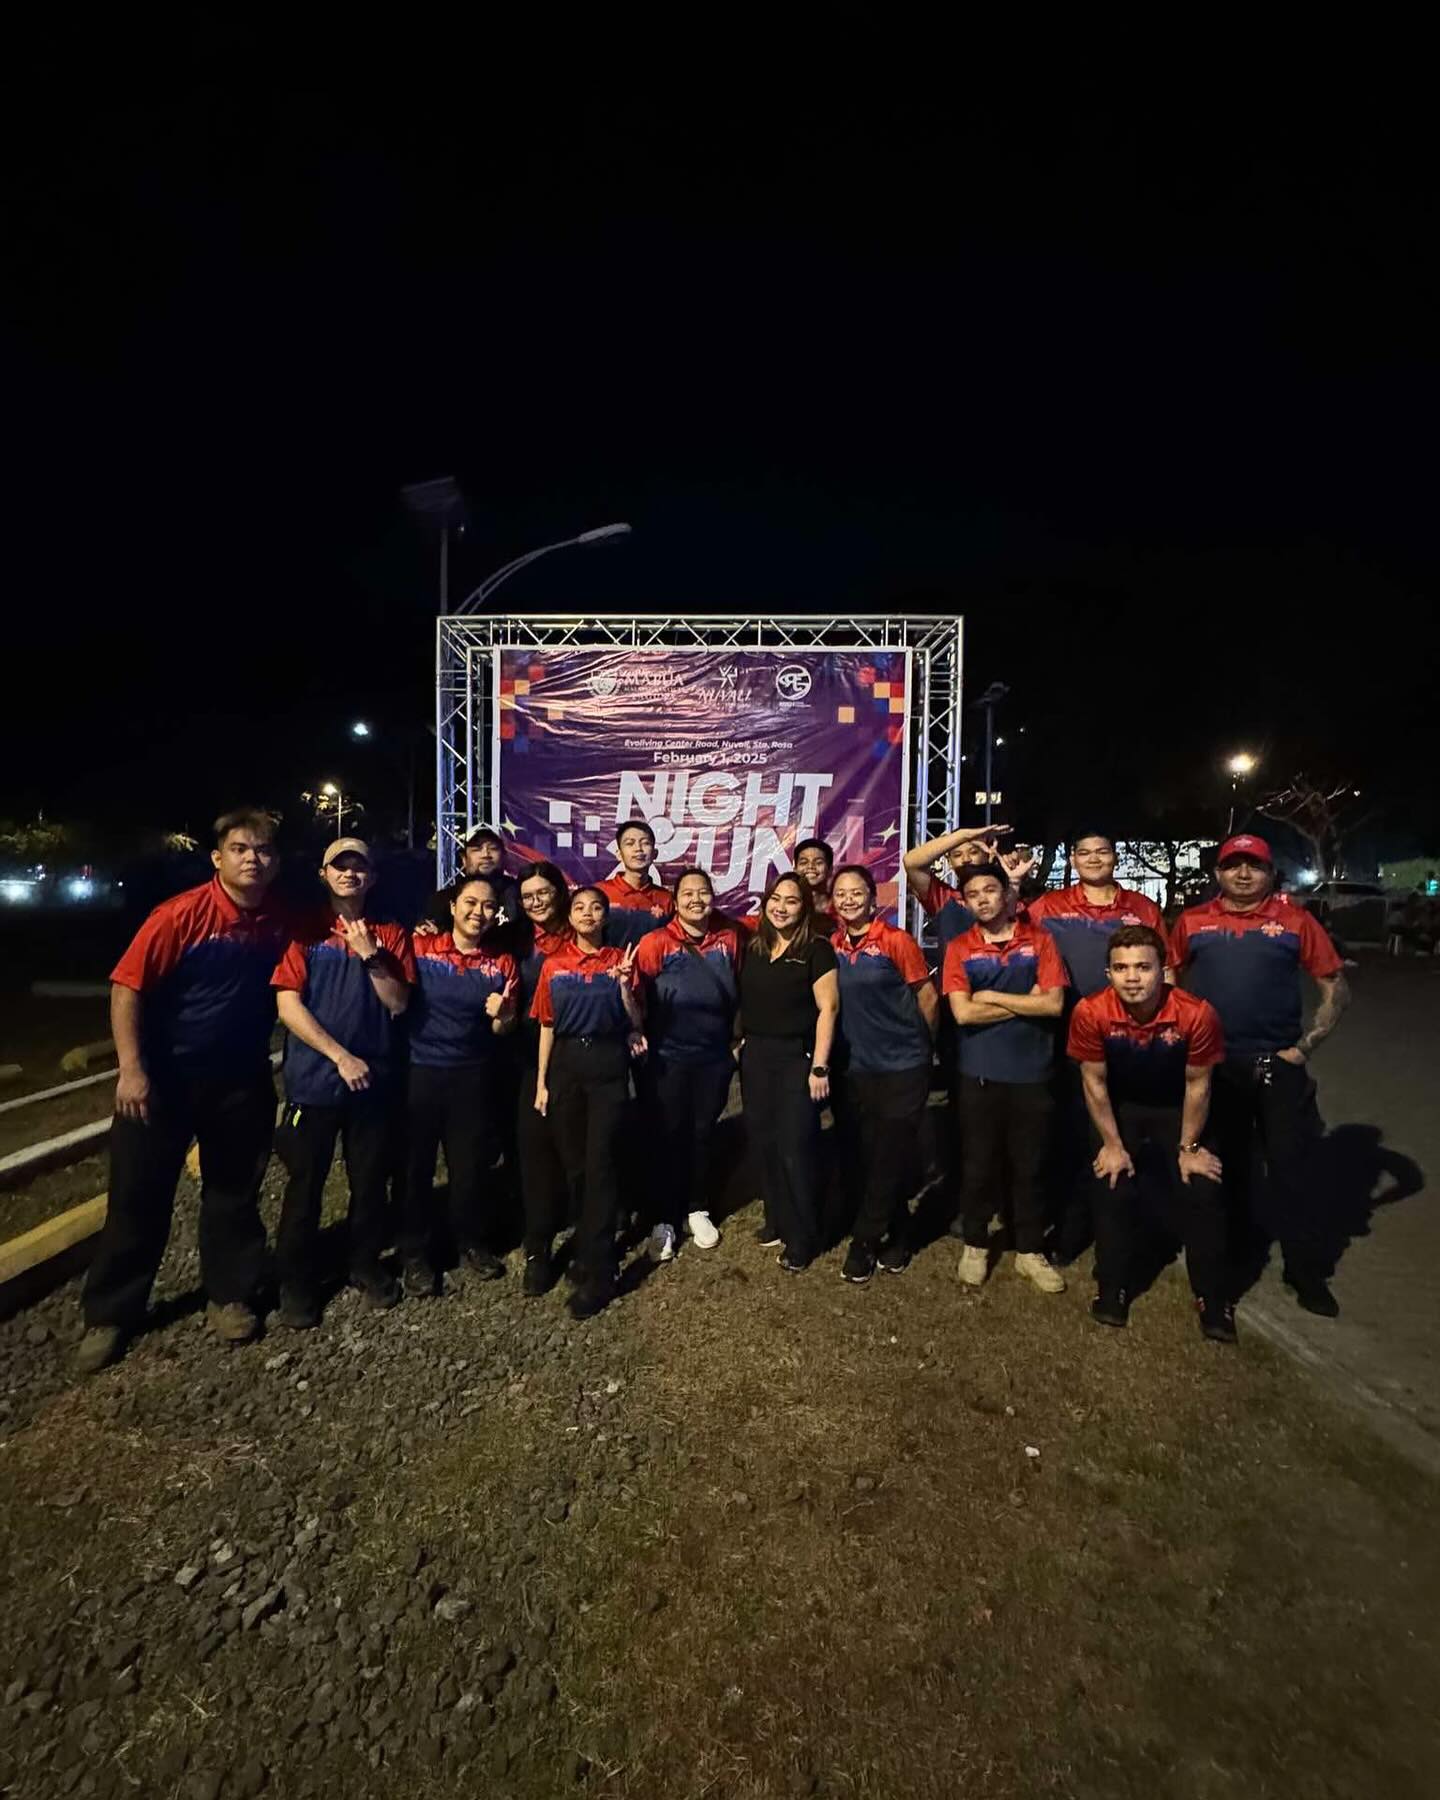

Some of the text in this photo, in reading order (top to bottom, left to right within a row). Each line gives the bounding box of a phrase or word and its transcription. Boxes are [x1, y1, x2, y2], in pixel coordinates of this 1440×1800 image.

[665, 740, 693, 748] Center
[653, 751, 719, 766] February
[734, 753, 768, 764] 2025
[616, 771, 833, 828] NIGHT
